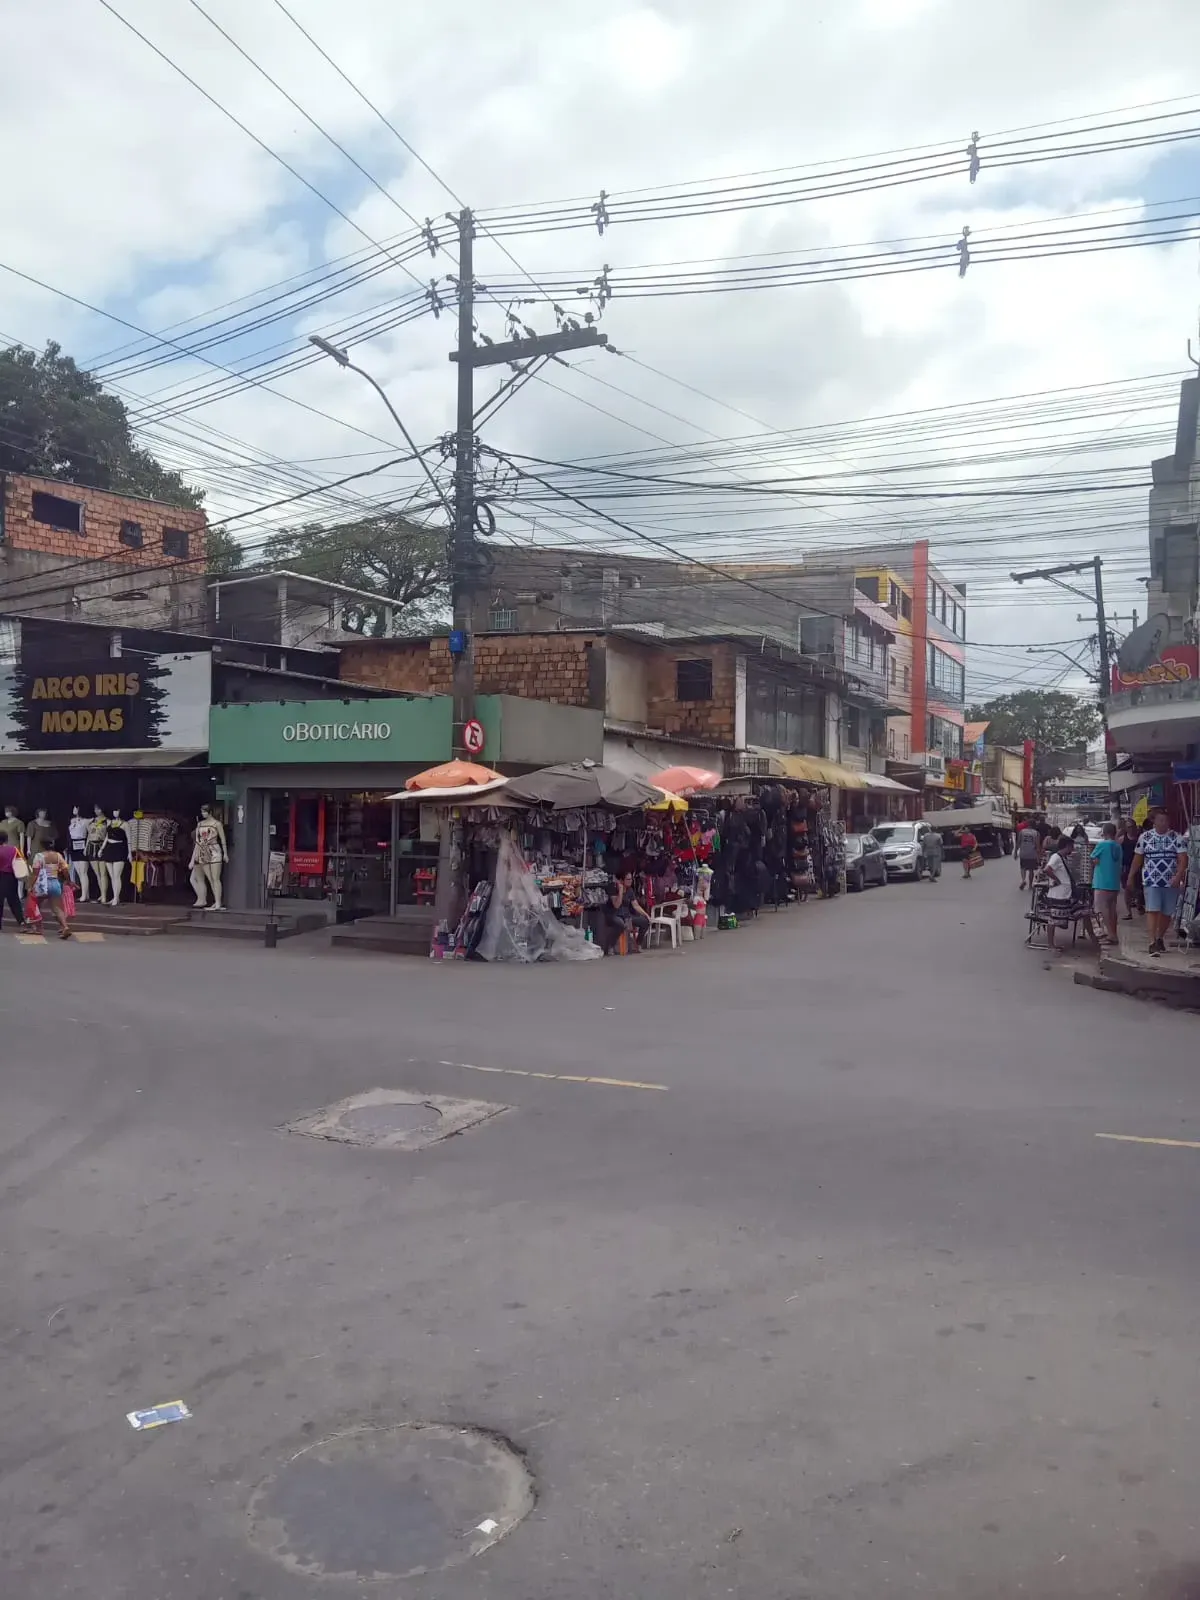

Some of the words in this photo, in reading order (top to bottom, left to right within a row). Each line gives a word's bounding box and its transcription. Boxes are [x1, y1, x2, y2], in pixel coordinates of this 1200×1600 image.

[31, 675, 90, 699] ARCO
[95, 673, 140, 696] IRIS
[41, 708, 124, 733] MODAS
